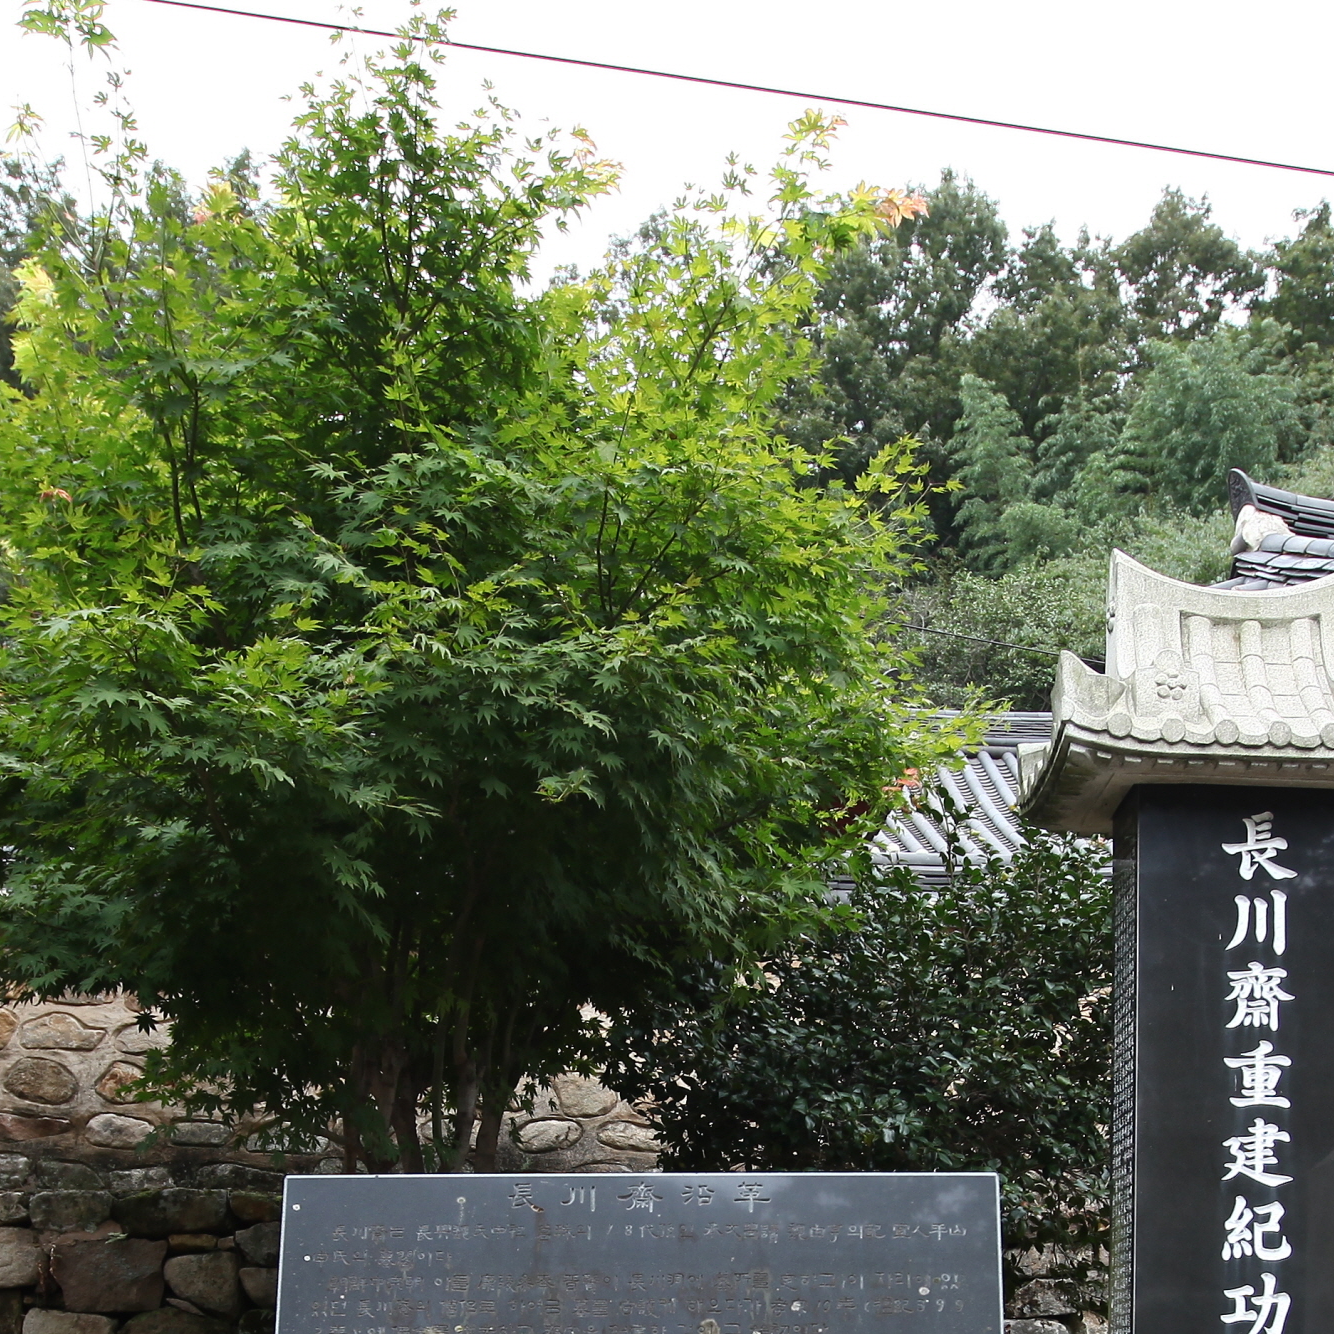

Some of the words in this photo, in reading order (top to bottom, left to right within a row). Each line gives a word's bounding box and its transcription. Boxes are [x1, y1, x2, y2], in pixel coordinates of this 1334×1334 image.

[508, 1180, 772, 1214] 長川齋沿革
